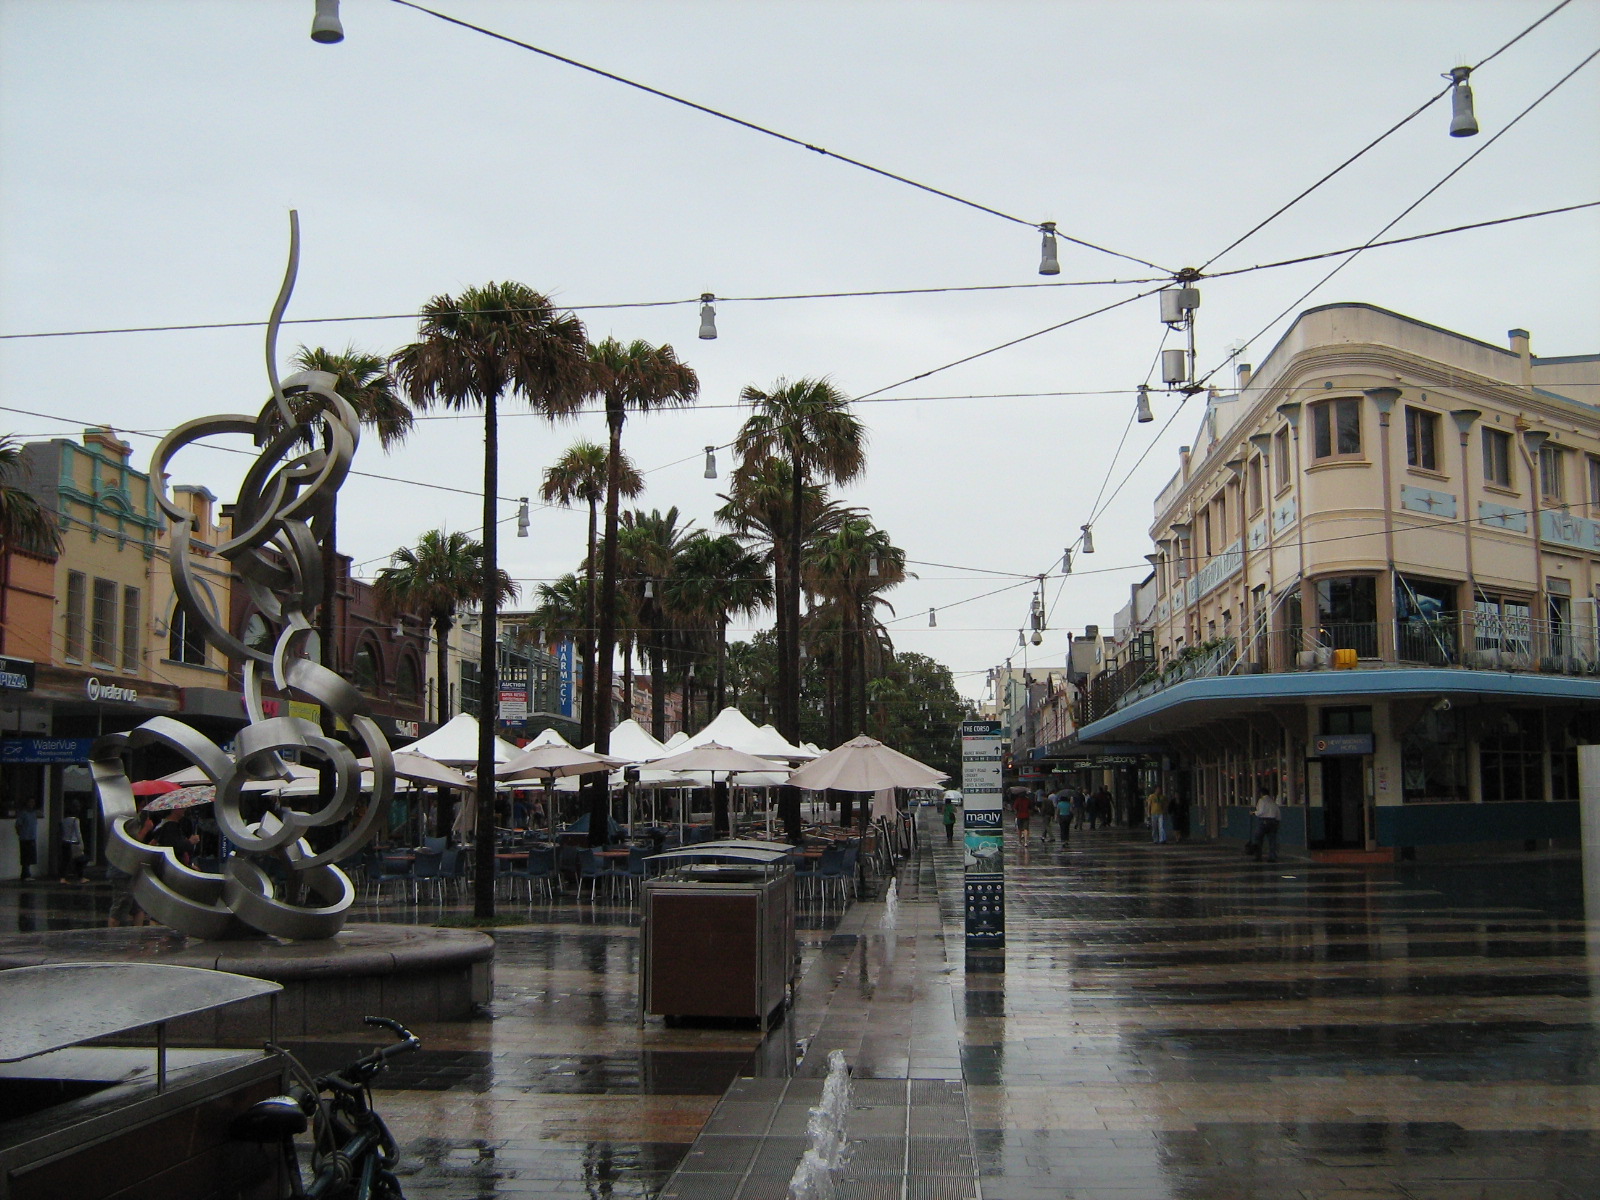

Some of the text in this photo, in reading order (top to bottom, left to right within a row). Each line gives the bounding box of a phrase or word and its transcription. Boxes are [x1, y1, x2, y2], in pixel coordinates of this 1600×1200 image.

[560, 641, 568, 706] HARMACY
[100, 683, 138, 702] watervue
[963, 725, 990, 733] THE CORSO
[32, 739, 77, 750] WaterVue
[966, 812, 1000, 824] manly
